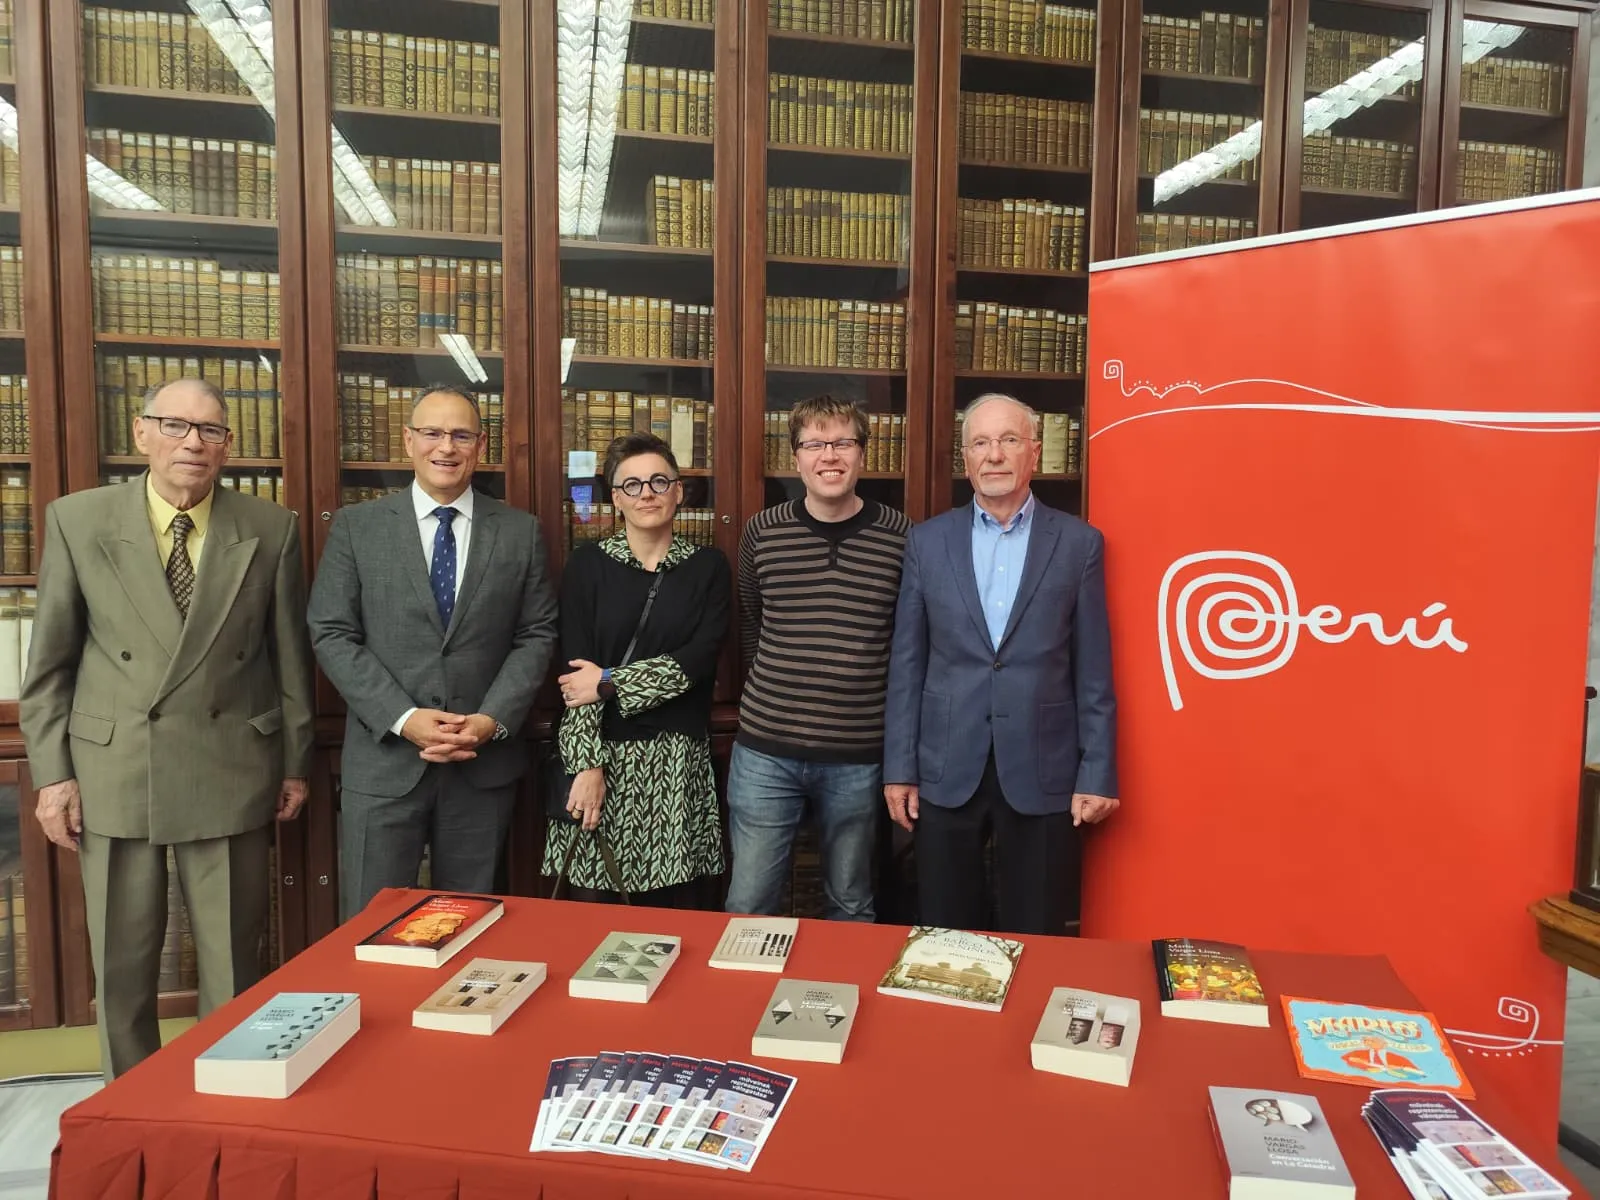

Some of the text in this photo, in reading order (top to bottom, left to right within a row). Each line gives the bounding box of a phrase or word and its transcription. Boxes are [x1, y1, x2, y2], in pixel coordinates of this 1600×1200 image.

[1158, 550, 1468, 711] Perú
[729, 1067, 747, 1075] Mario
[748, 1072, 770, 1082] Vargas
[1265, 1141, 1306, 1150] VARGAS
[1269, 1153, 1330, 1165] Conversación
[1297, 1161, 1336, 1171] Catedral
